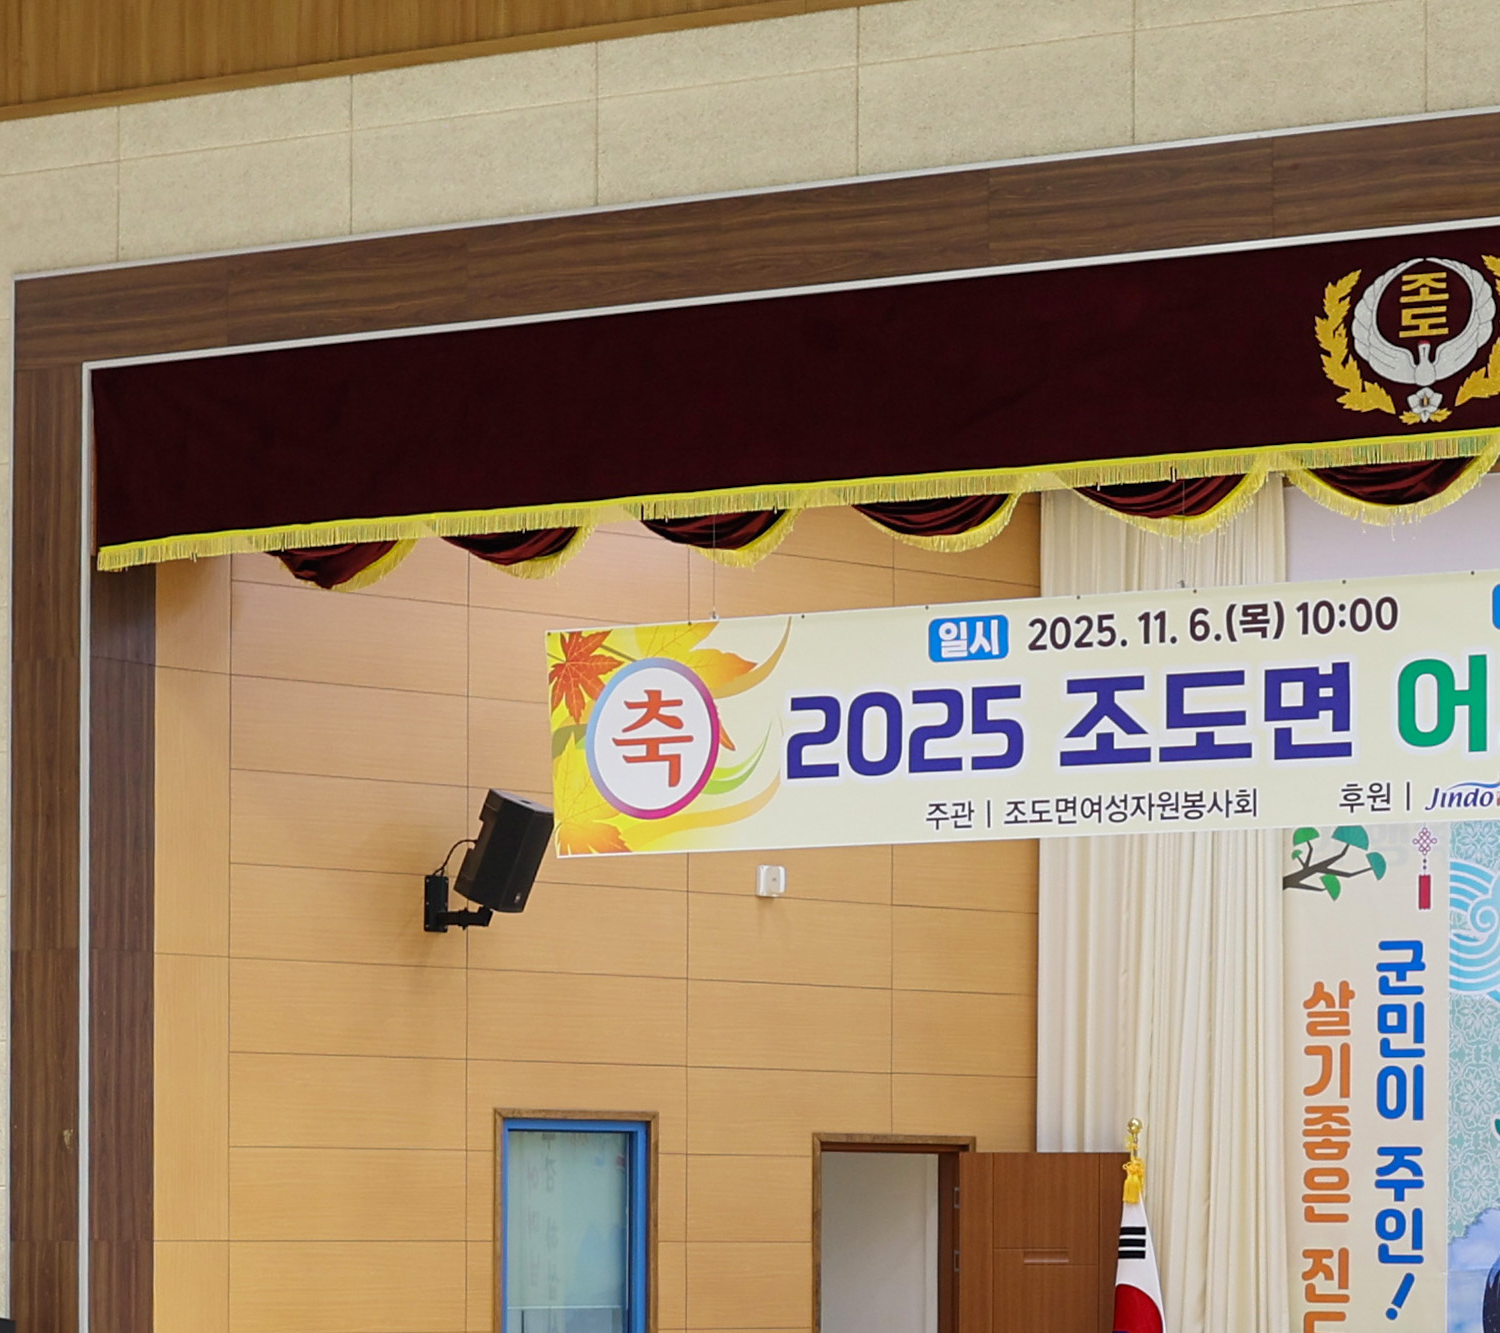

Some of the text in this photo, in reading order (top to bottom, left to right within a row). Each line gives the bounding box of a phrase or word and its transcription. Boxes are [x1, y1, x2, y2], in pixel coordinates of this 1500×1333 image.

[1399, 271, 1449, 338] 조도
[937, 620, 1001, 657] 일시
[1028, 597, 1398, 650] 2025. 11. 6.(목) 10:00
[612, 689, 694, 788] 축
[787, 685, 1023, 779] 2025
[1060, 662, 1352, 766] 조도면
[926, 789, 1256, 830] 주관 조도면여성자원봉사회
[1340, 783, 1390, 813] 후원
[1302, 981, 1355, 1223] 살기좋은
[1375, 940, 1426, 1320] 군민이 주인!
